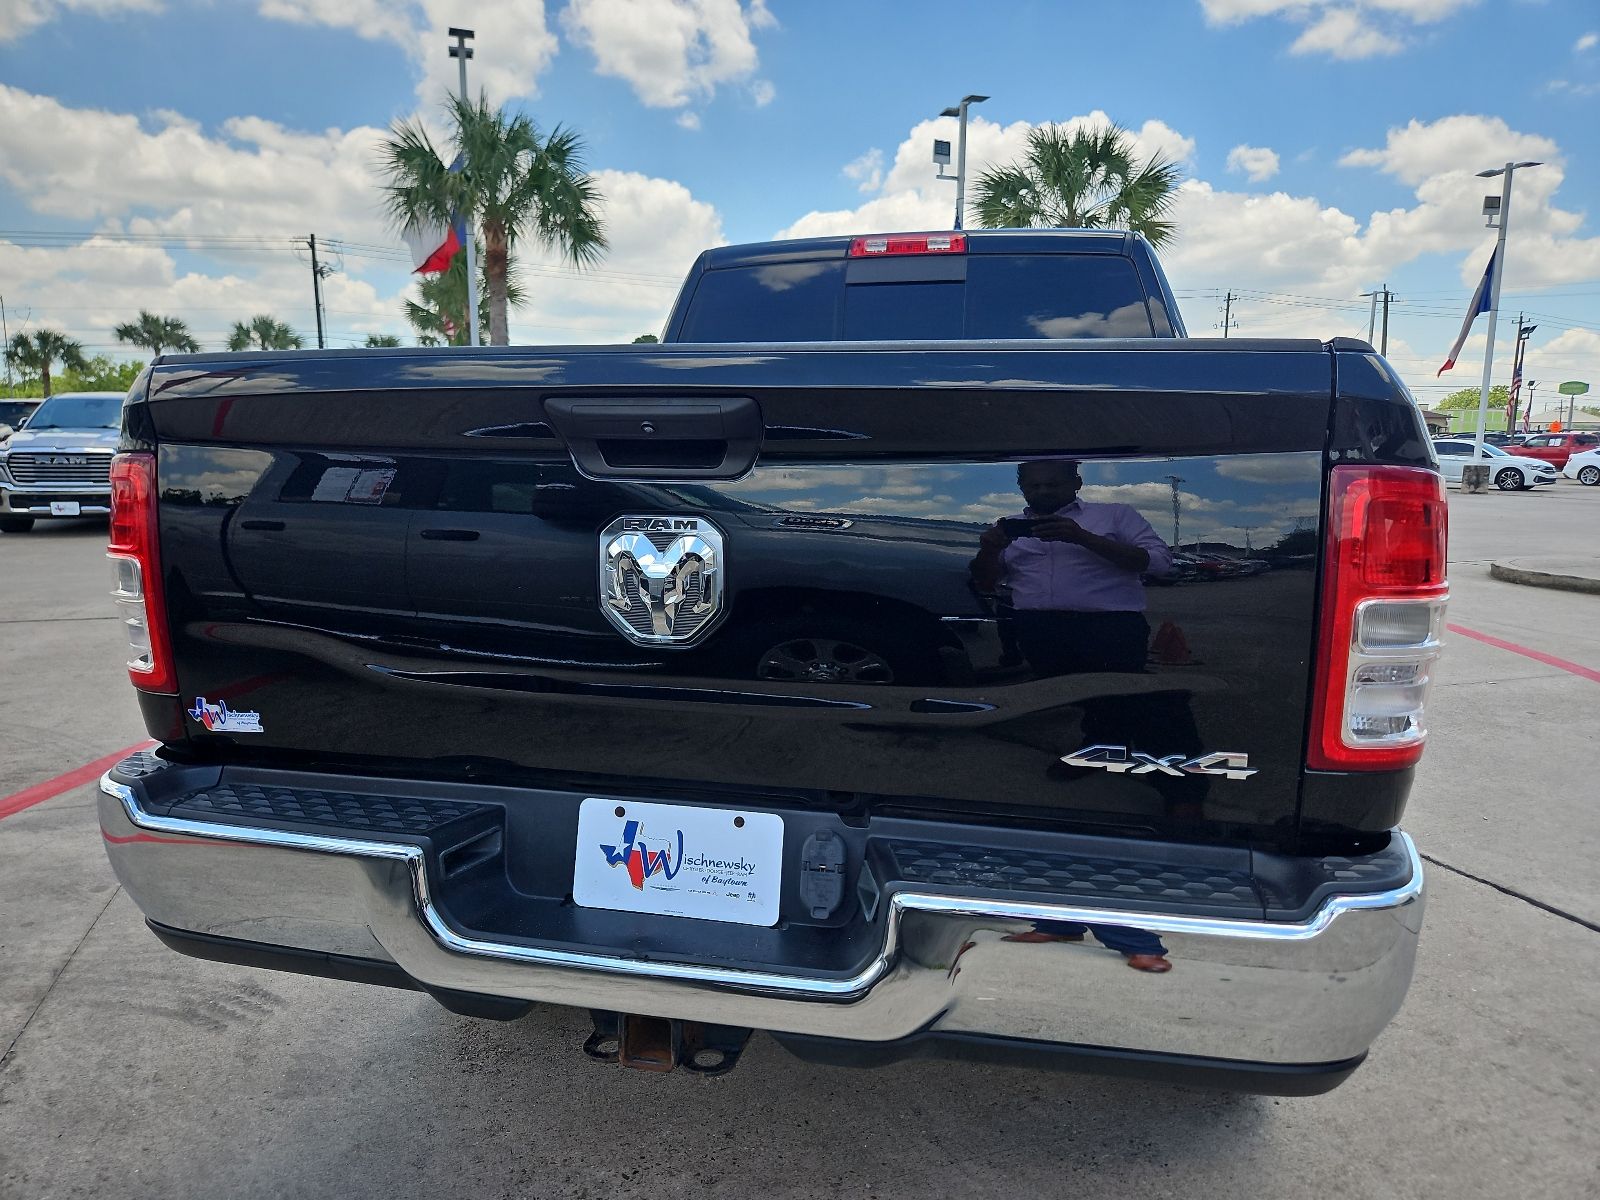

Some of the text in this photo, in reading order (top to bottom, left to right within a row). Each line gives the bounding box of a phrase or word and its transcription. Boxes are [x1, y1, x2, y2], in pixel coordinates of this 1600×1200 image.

[34, 455, 88, 464] RAM
[623, 518, 698, 530] RAM
[1060, 745, 1260, 780] 4x4
[638, 830, 756, 880] Wischnewsky
[701, 875, 749, 887] of Baytown
